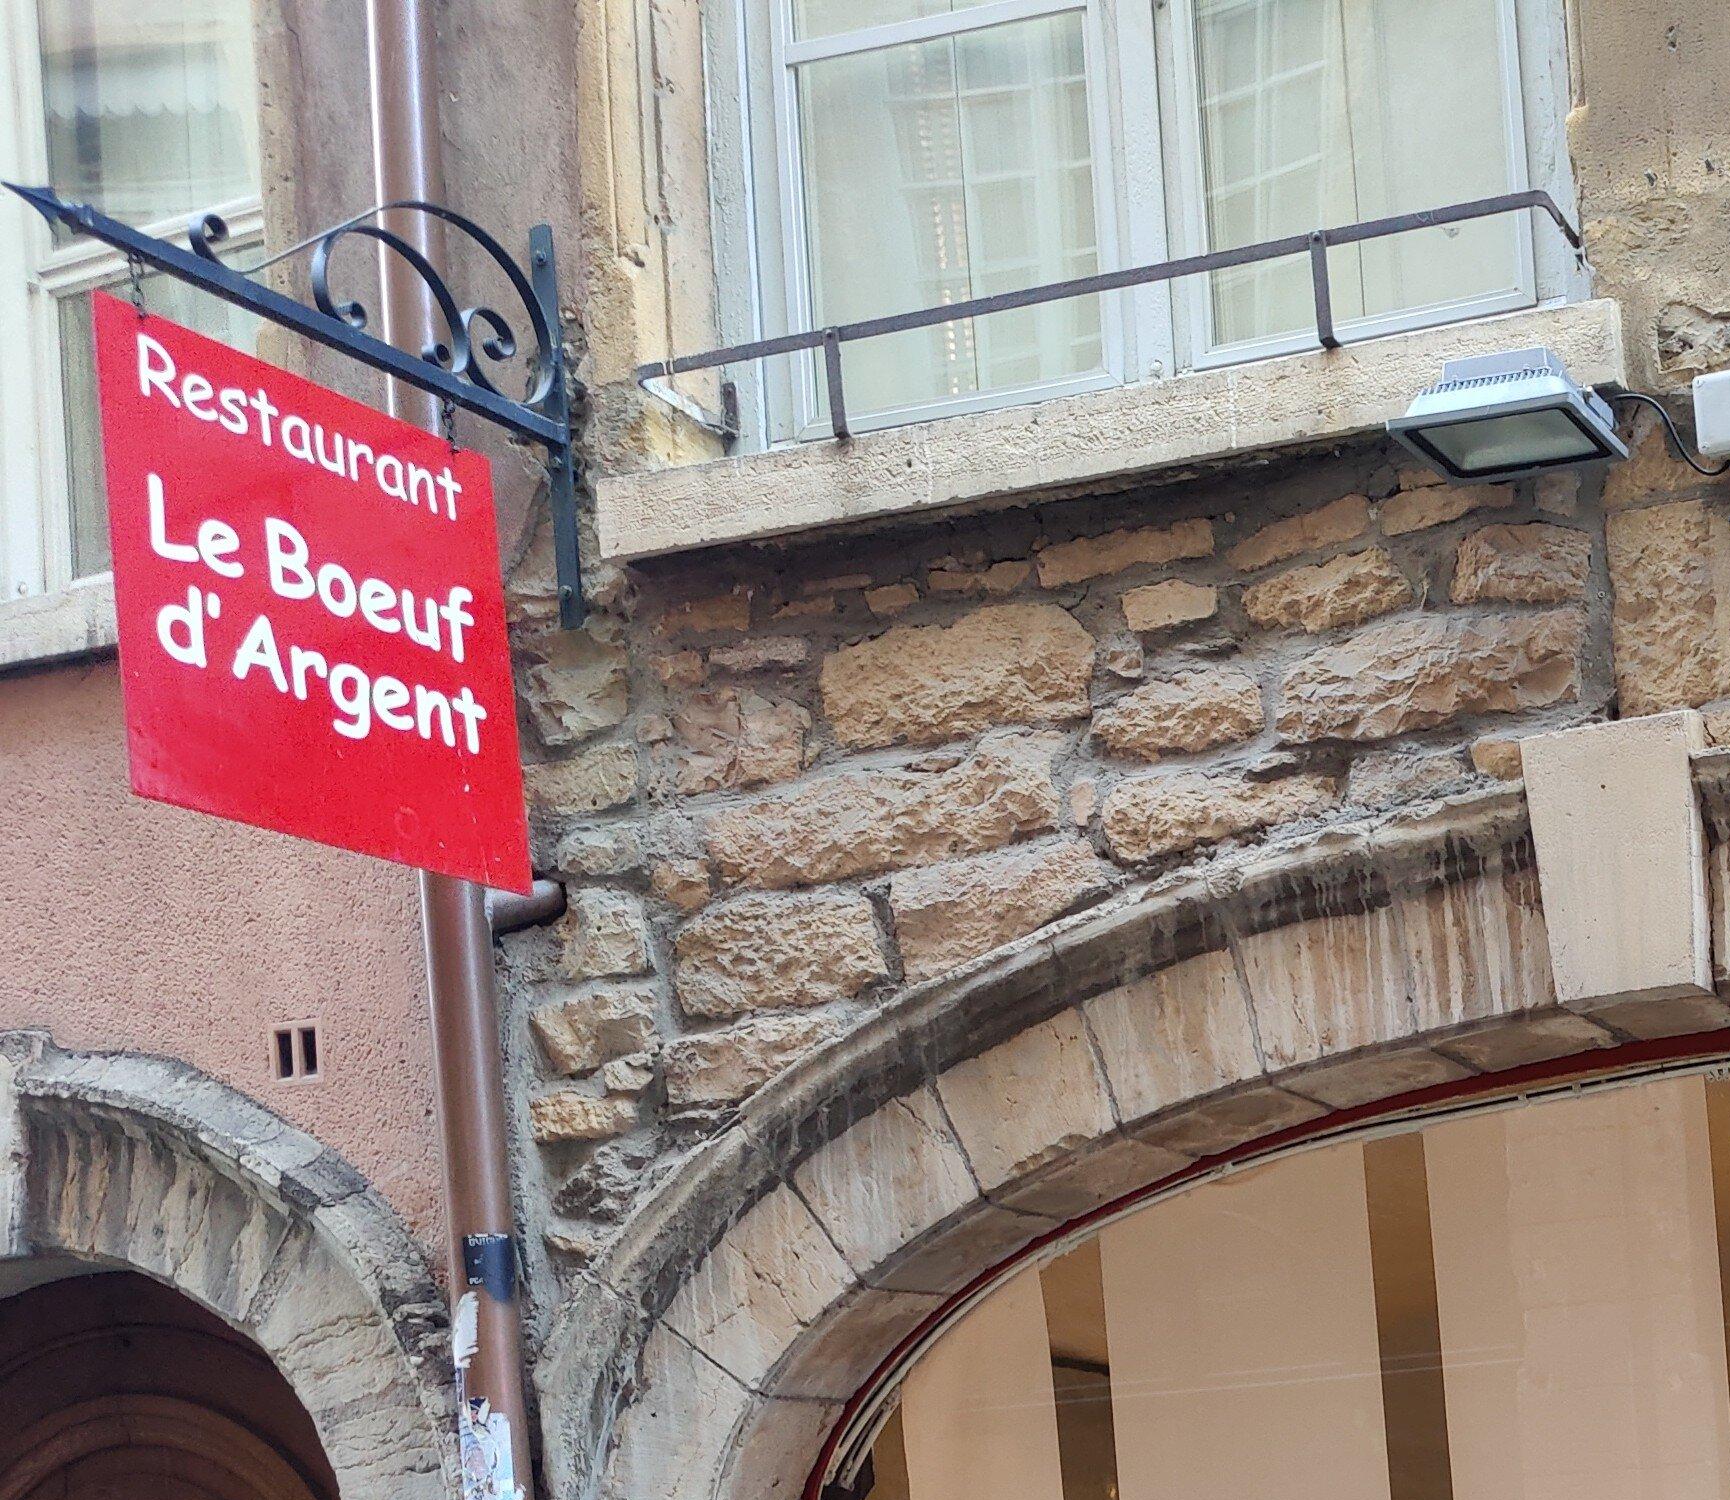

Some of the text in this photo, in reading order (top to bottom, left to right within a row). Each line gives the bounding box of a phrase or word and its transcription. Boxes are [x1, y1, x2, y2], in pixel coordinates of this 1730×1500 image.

[136, 332, 463, 522] Restaurant
[146, 472, 475, 664] Le Boeuf
